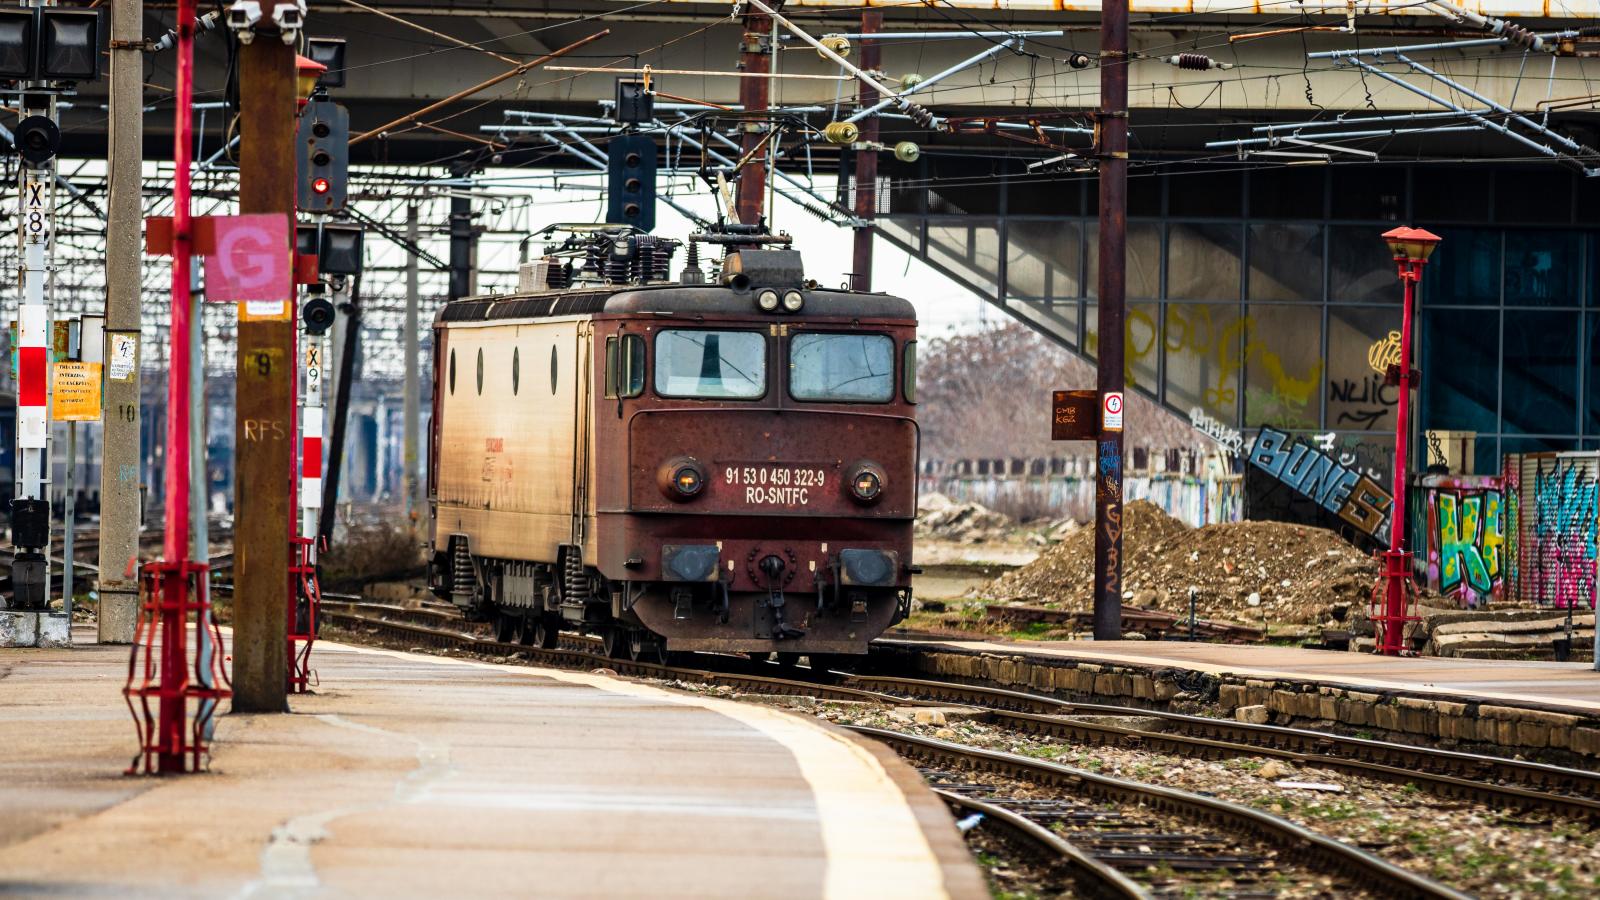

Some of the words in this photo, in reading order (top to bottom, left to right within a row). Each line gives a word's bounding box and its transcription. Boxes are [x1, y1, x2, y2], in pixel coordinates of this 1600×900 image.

[219, 226, 275, 288] G
[257, 352, 271, 376] 9
[118, 404, 135, 423] 10
[244, 419, 285, 442] RFS
[726, 467, 739, 484] 91
[743, 467, 757, 485] 53
[760, 468, 767, 485] 0
[770, 468, 791, 486] 450
[794, 469, 825, 487] 322-9
[1249, 424, 1394, 536] BUNES
[746, 487, 809, 505] RO-SNTFC
